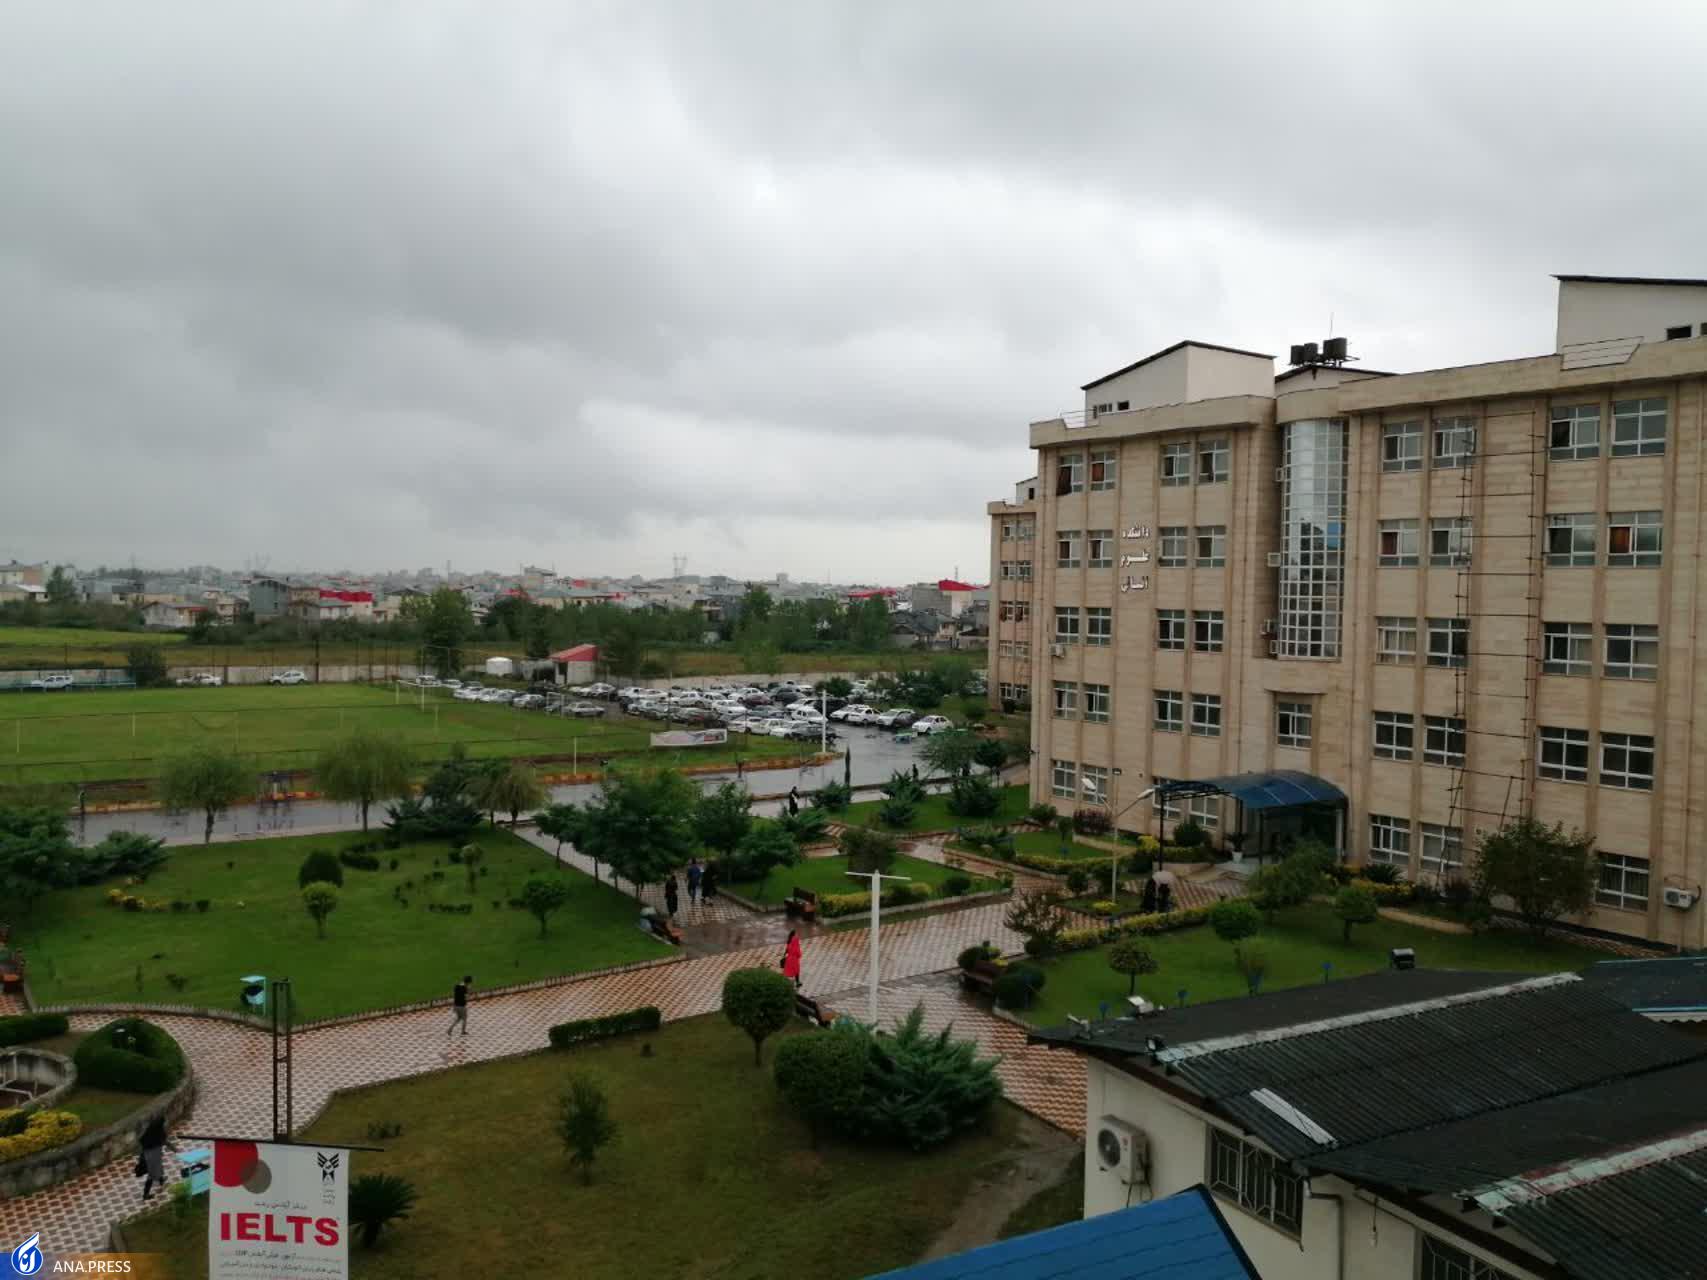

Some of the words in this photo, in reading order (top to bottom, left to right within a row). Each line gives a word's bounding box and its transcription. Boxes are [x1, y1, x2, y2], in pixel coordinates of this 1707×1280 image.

[1122, 523, 1149, 539] دانشکده
[1120, 551, 1149, 567] علوم
[220, 1213, 339, 1246] IELTS
